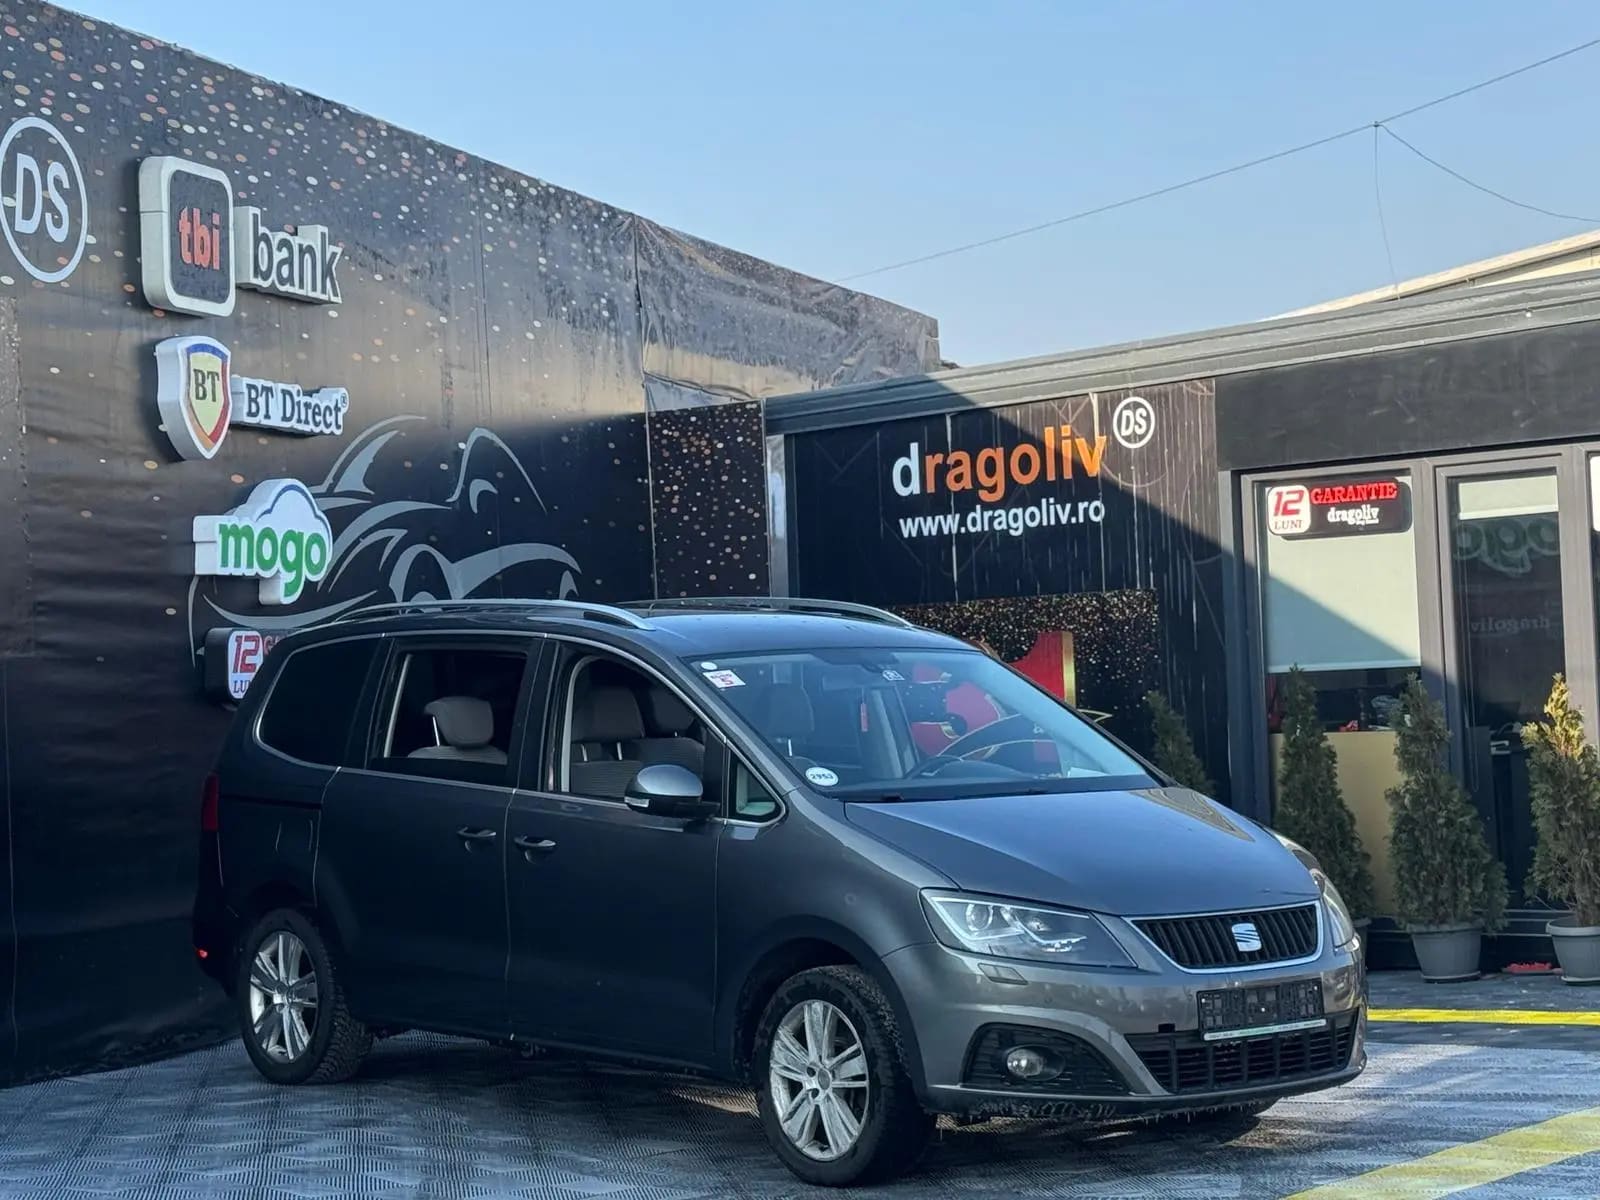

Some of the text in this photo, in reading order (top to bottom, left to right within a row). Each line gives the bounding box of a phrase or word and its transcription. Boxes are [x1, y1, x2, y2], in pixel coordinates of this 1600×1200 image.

[15, 153, 70, 243] DS
[178, 206, 339, 298] tbi bank
[192, 368, 219, 403] BT
[246, 383, 274, 419] BT
[1121, 408, 1147, 437] DS
[892, 425, 1107, 502] dragoliv
[1273, 489, 1305, 517] 12
[1310, 482, 1397, 504] GARANTIE
[899, 498, 1105, 538] www.dragoliv.ro
[219, 523, 327, 597] mogo
[232, 635, 260, 674] 12
[233, 680, 250, 694] LU
